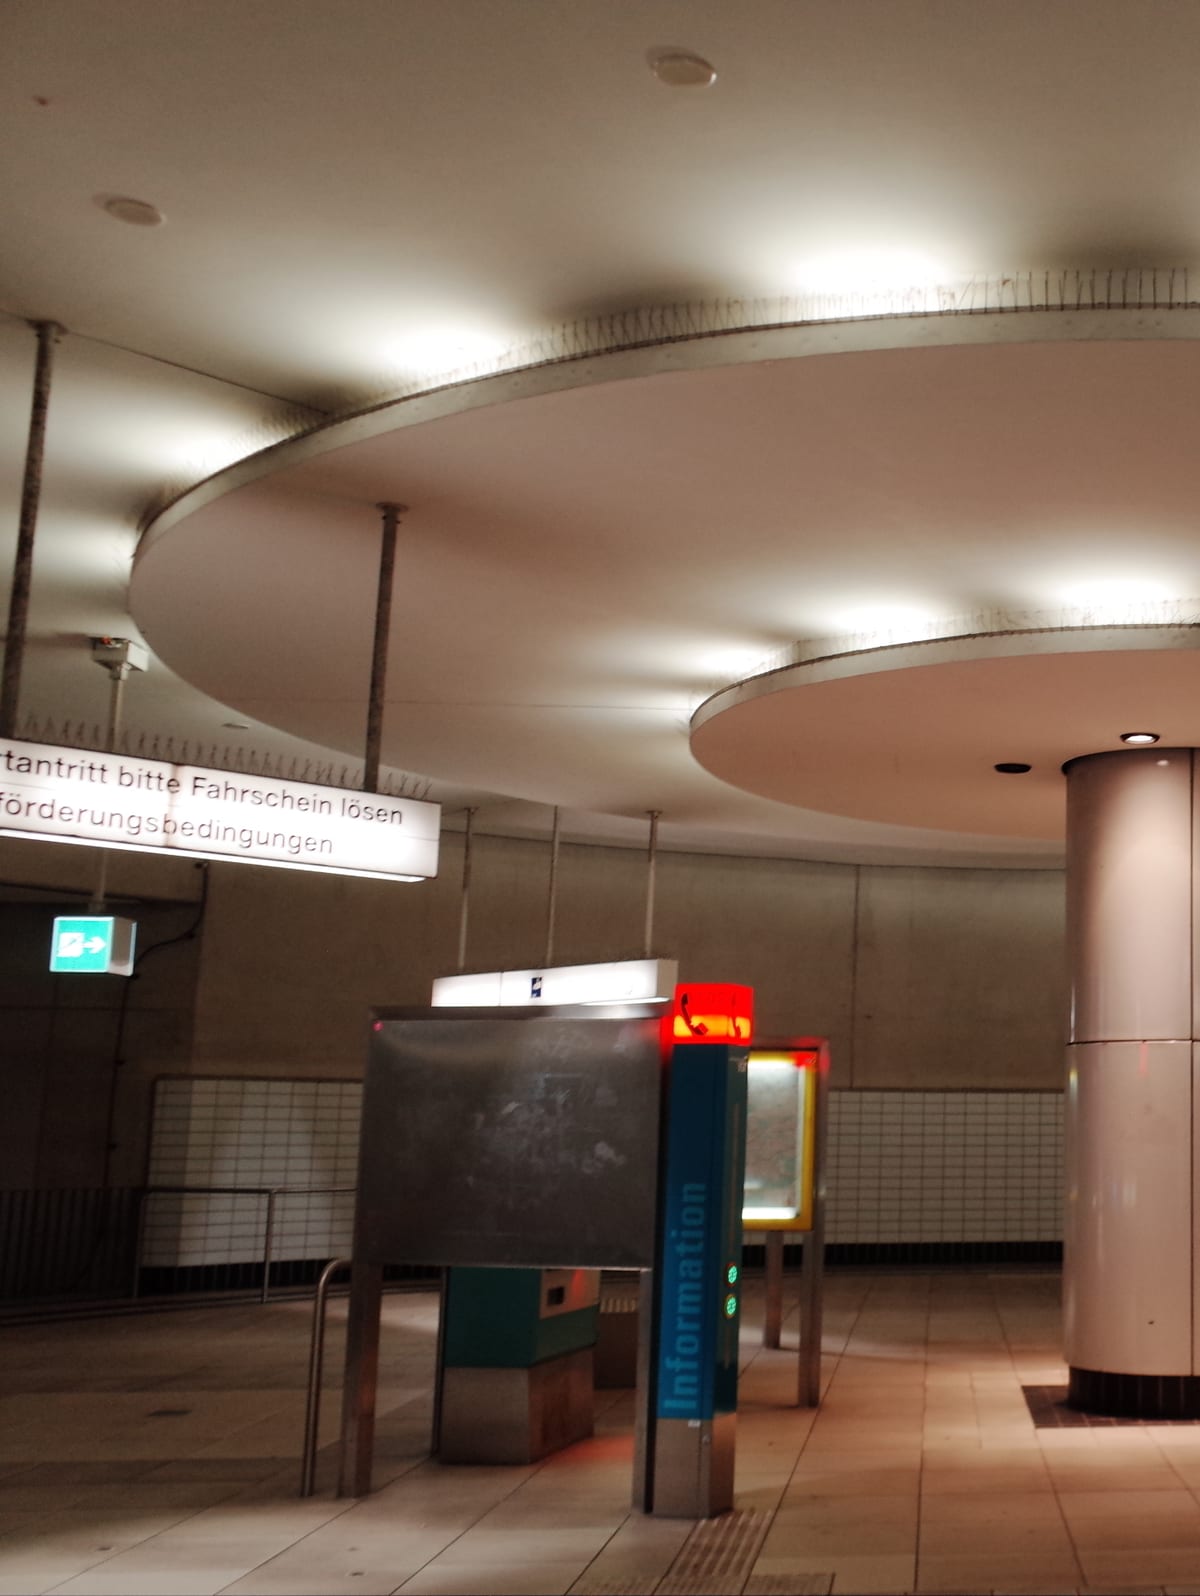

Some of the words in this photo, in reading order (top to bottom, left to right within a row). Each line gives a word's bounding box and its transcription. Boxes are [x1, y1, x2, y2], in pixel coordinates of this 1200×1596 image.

[0, 750, 108, 784] tantritt
[118, 765, 181, 795] bitte
[191, 776, 333, 816] Fahrschein
[340, 797, 404, 825] lösen
[664, 1183, 706, 1410] Information
